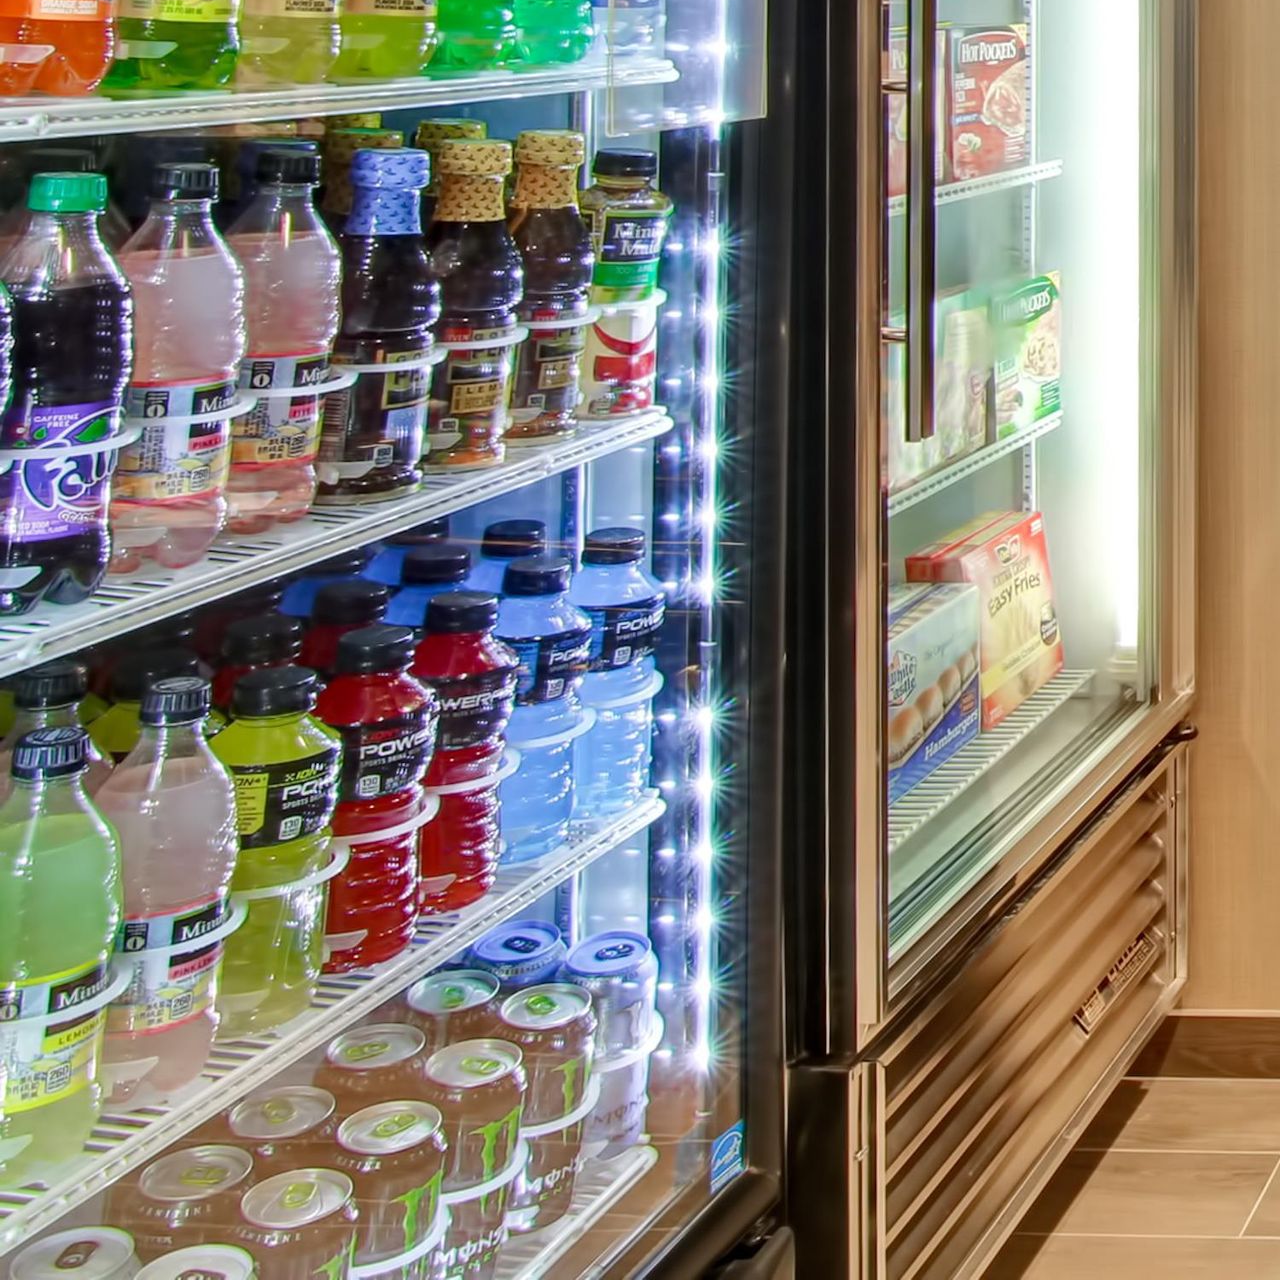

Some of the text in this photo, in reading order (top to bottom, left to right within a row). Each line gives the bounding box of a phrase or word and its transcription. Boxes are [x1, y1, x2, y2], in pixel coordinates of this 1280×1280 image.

[33, 412, 80, 423] CAFFEINE
[47, 420, 71, 428] FREE
[988, 572, 1042, 619] Easy Fries
[925, 708, 979, 761] Hamburgers
[172, 994, 192, 1009] 260
[50, 1064, 69, 1080] 260
